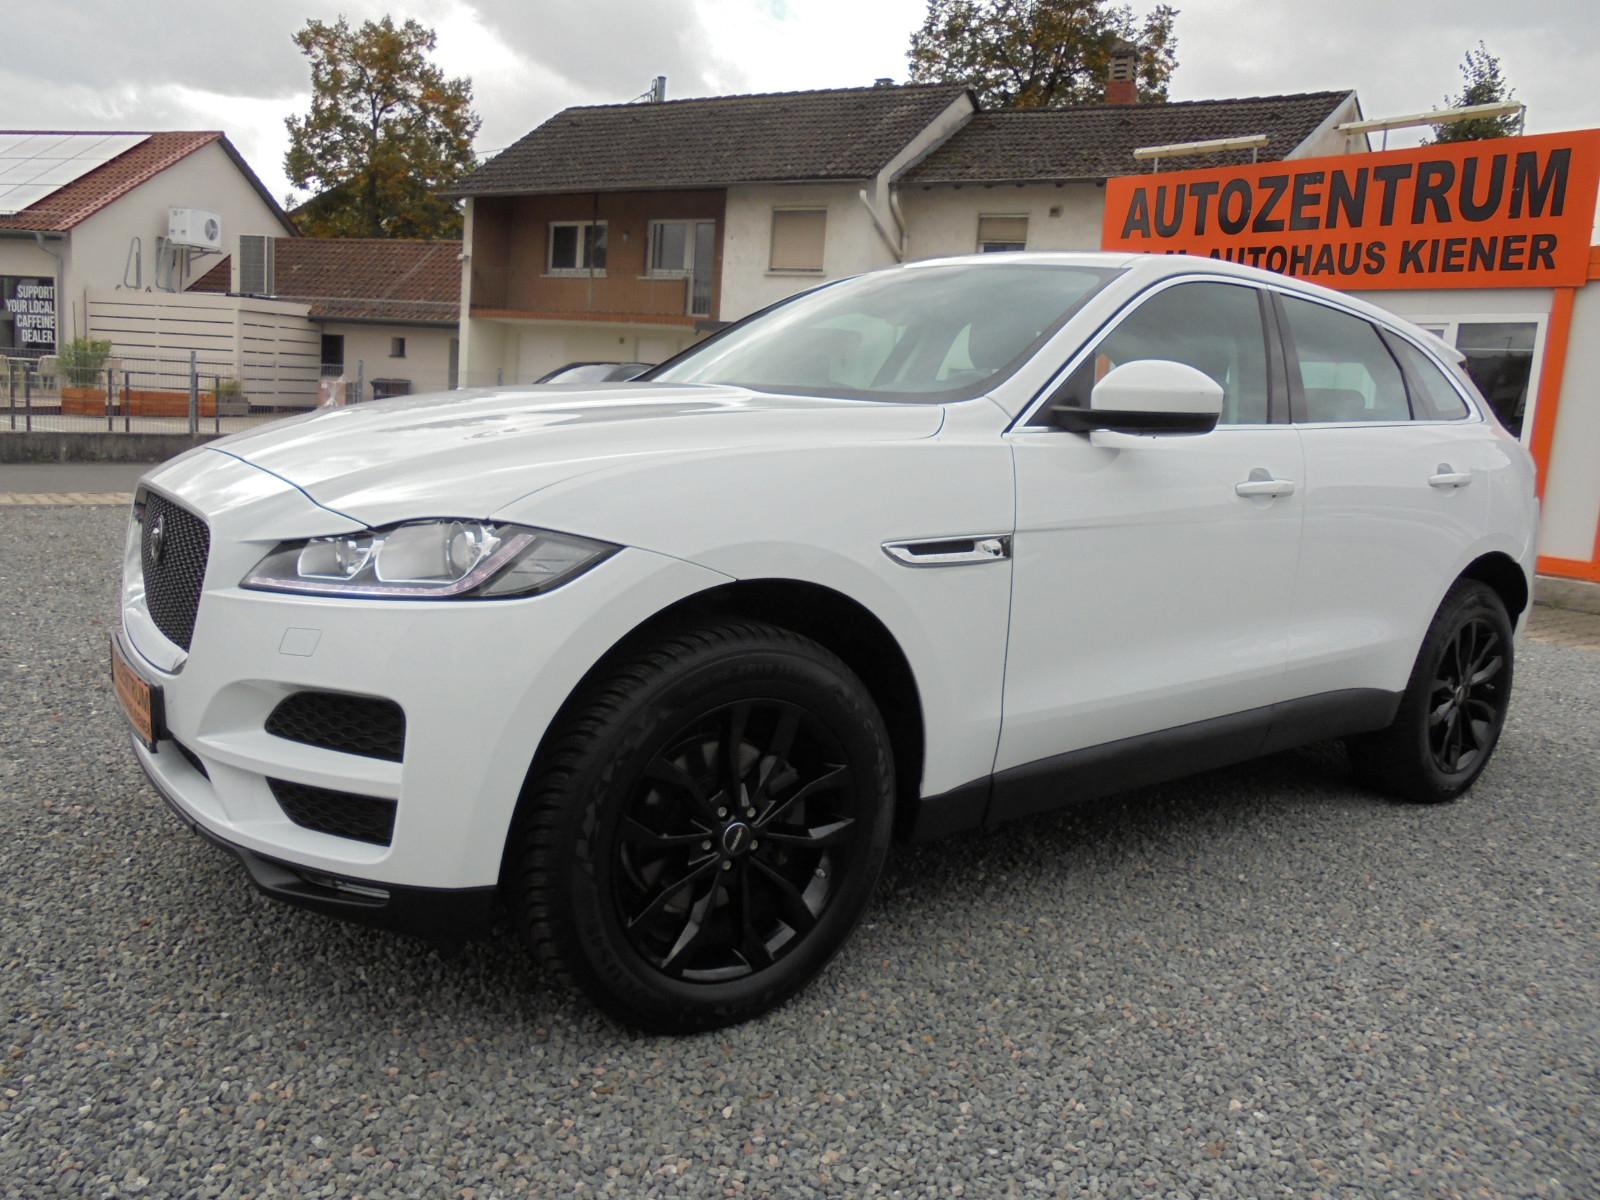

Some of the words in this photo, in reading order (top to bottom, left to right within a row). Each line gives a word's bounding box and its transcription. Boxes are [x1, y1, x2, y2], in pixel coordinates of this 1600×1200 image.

[1120, 147, 1572, 239] AUTOZENTRUM
[1398, 233, 1557, 274] KIENER
[17, 285, 54, 299] SUPPORT
[6, 299, 28, 313] YOUR
[29, 300, 54, 314] LOCAL
[16, 314, 55, 329] CAFFEINE
